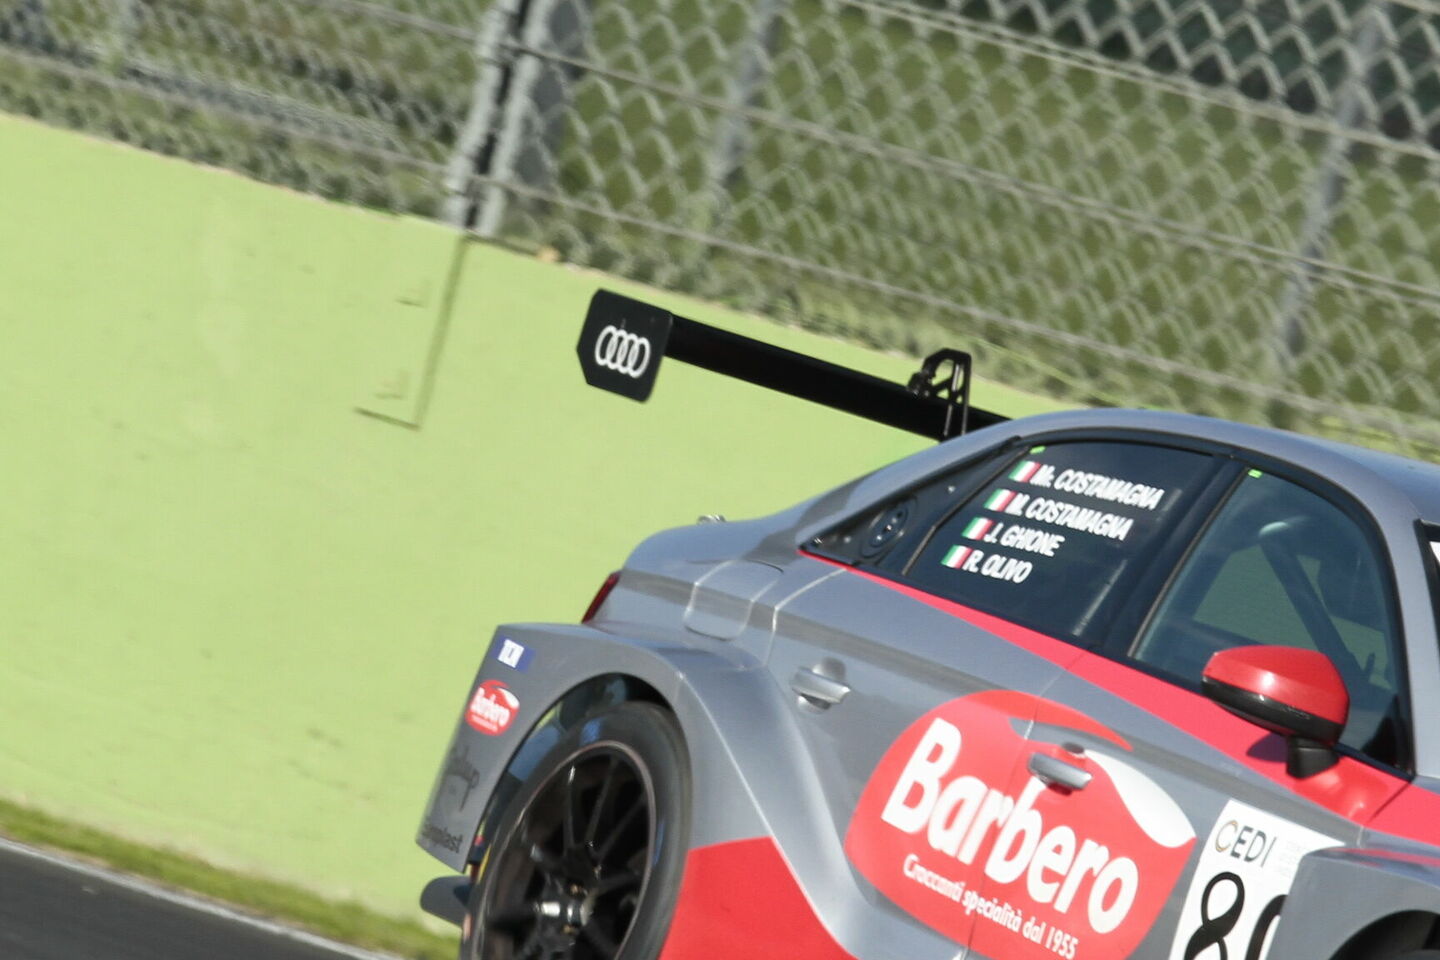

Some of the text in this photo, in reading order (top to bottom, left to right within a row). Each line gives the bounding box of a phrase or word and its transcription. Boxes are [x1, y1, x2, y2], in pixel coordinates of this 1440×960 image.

[1053, 469, 1165, 511] COSTAMAGNA
[983, 522, 1065, 557] J. GHIONE
[1025, 497, 1134, 541] COSTAMAGNA
[962, 549, 1033, 584] R. OLIVO
[881, 717, 1139, 934] Barbero
[1215, 819, 1277, 868] CEDI
[903, 853, 1079, 960] Croccanti specialità dal 1955
